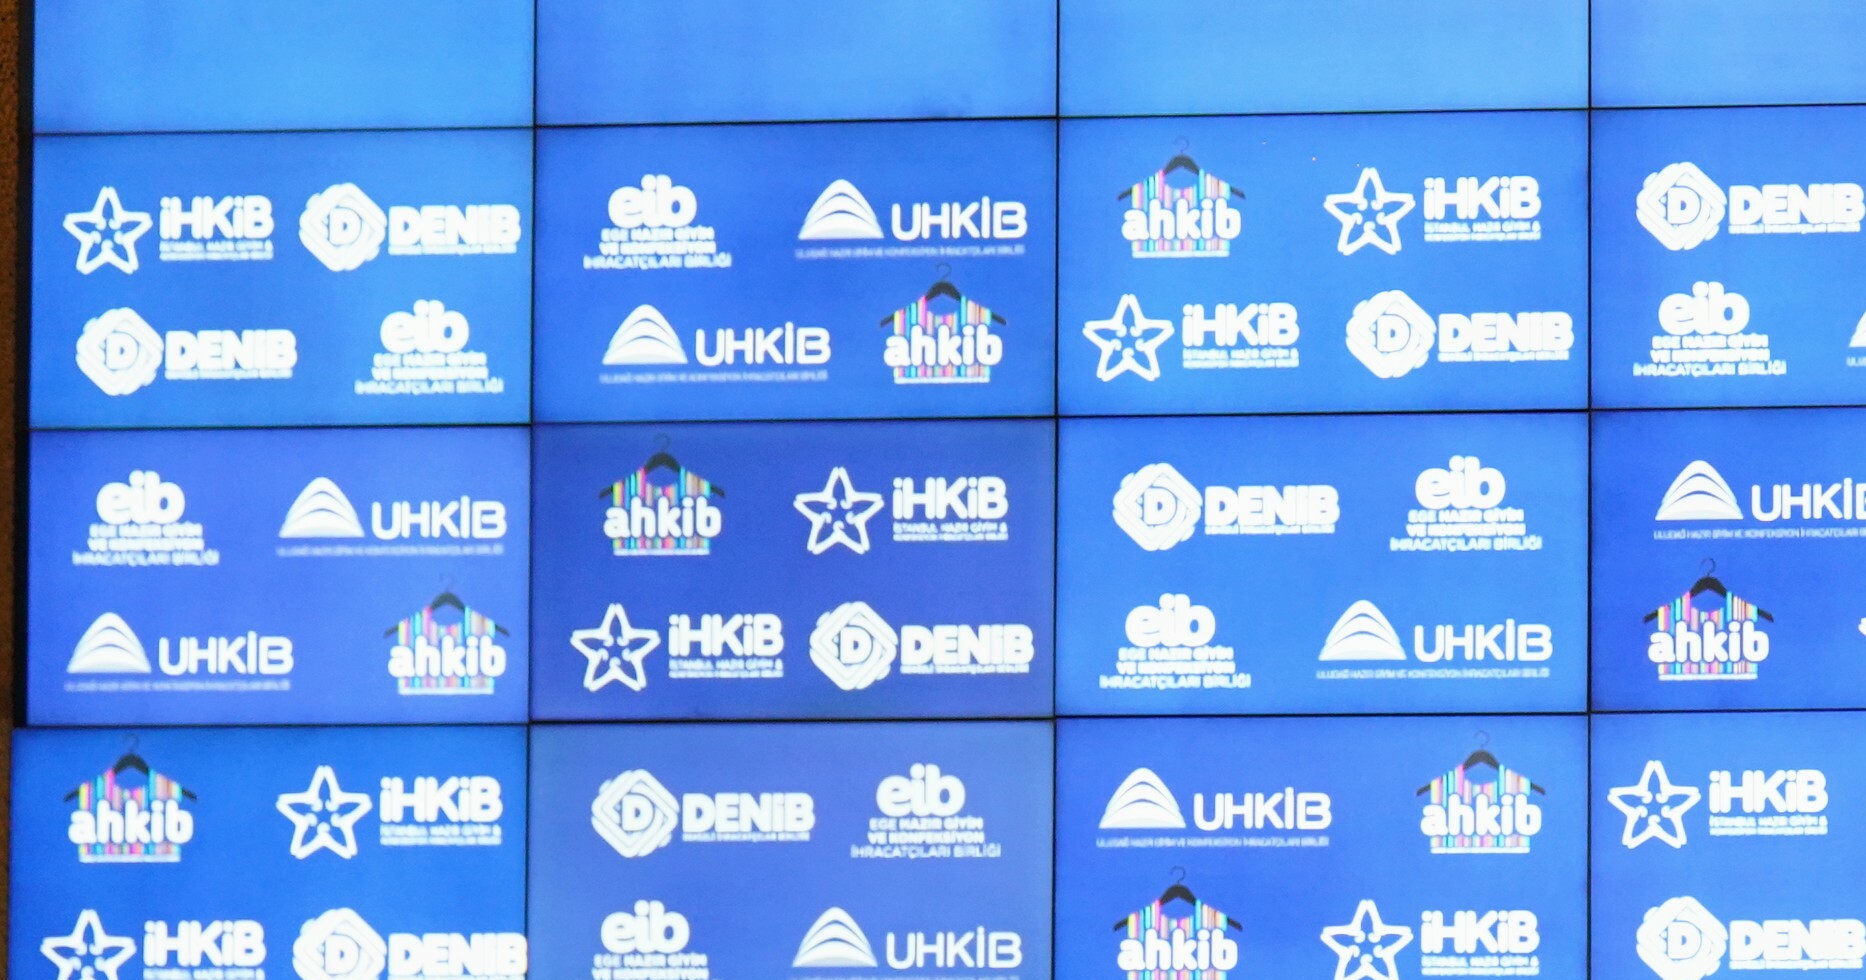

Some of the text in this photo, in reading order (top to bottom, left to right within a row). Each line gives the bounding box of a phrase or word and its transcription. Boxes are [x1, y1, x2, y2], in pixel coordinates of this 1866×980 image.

[609, 175, 697, 227] eib
[892, 197, 1027, 241] UHKİB
[1123, 197, 1240, 242] ahkib
[381, 300, 469, 352] eib
[1659, 282, 1750, 335] eib
[696, 322, 831, 366] UHKİB
[885, 325, 1002, 367] ahkib
[97, 471, 185, 523] eib
[1415, 456, 1506, 509] eib
[372, 496, 506, 539] UHKİB
[605, 495, 721, 538] ahkib
[1125, 594, 1215, 647] eib
[1415, 619, 1552, 662] UHKİB
[1649, 619, 1768, 664] ahkib
[159, 631, 293, 675] UHKİB
[389, 635, 505, 678] ahkib
[877, 764, 965, 817] eib
[1194, 787, 1332, 830] UHKİB
[69, 799, 193, 845] ahkib
[1421, 792, 1541, 837] ahkib
[601, 901, 689, 953] eib
[887, 927, 1022, 969] UHKİB
[1118, 927, 1237, 972] ahkib
